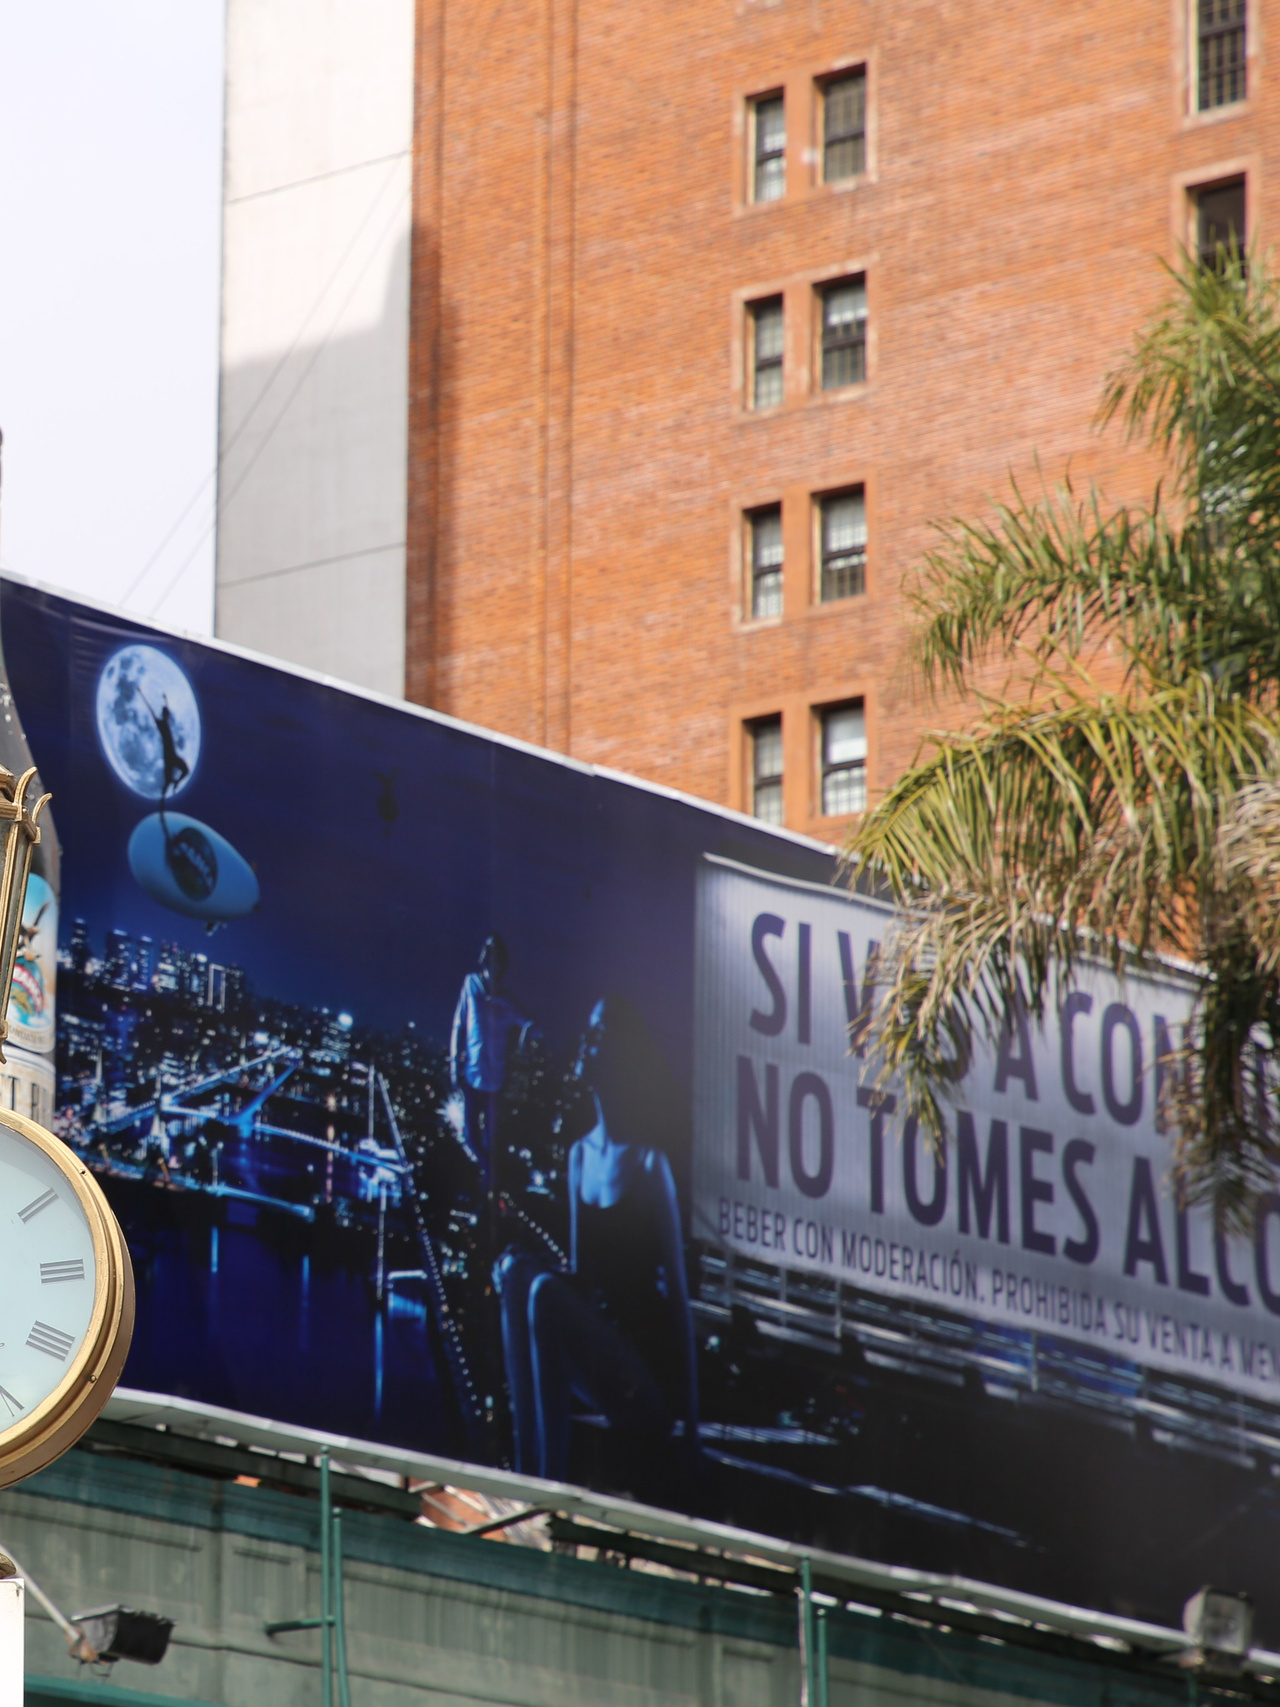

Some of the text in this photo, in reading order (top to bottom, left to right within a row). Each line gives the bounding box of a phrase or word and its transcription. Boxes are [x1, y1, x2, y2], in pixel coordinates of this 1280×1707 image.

[750, 912, 813, 1046] SI
[16, 1187, 60, 1224] II
[736, 1054, 834, 1199] NO
[856, 1085, 1102, 1265] TOMES
[39, 1257, 85, 1284] III
[718, 1199, 786, 1251] BEBER
[792, 1217, 834, 1264] CON
[841, 1230, 986, 1304] MODERACIÓN.
[992, 1268, 1108, 1335] PROHIBIDA
[1113, 1301, 1140, 1344] SU
[1145, 1311, 1215, 1366] VENTA
[1219, 1331, 1234, 1372] A
